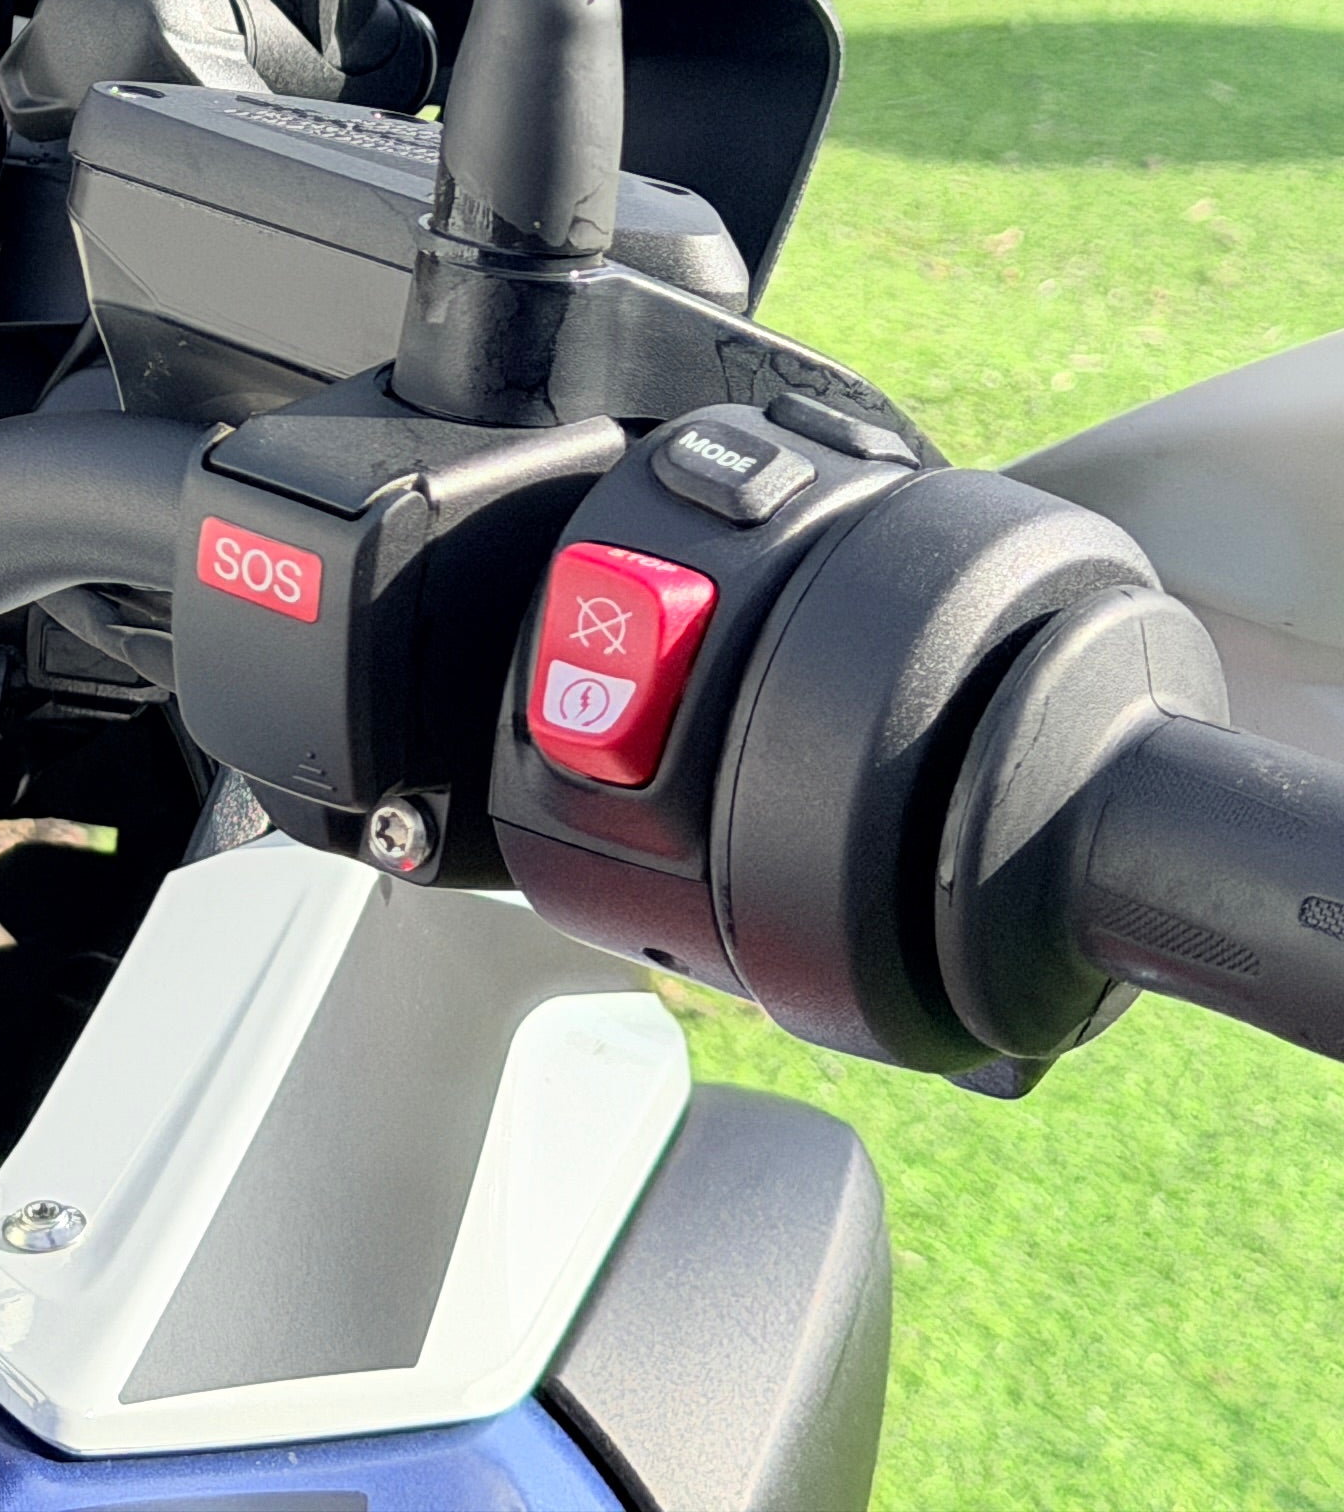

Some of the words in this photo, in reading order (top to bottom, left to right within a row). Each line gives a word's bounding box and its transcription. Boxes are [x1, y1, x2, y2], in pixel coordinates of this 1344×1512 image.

[678, 430, 758, 473] MODE
[213, 537, 303, 603] SOS
[607, 548, 678, 572] STOP
